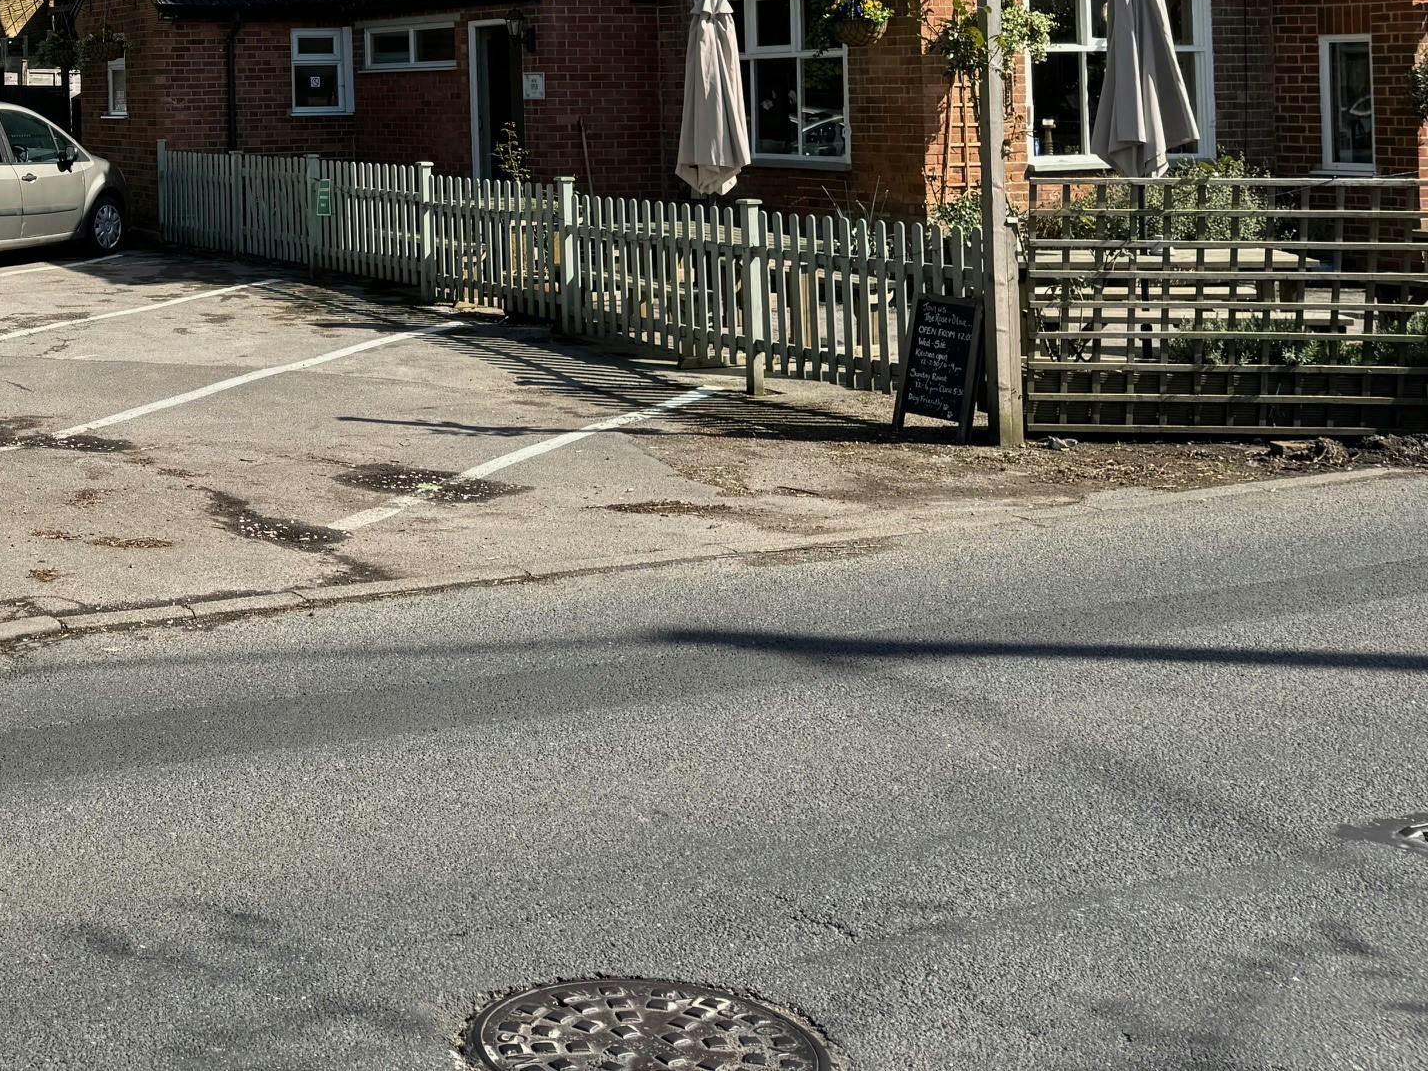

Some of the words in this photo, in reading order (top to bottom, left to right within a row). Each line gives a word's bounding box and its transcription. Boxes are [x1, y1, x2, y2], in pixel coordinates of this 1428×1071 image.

[924, 312, 934, 323] The
[918, 325, 938, 336] OPEN
[938, 328, 955, 339] FROM
